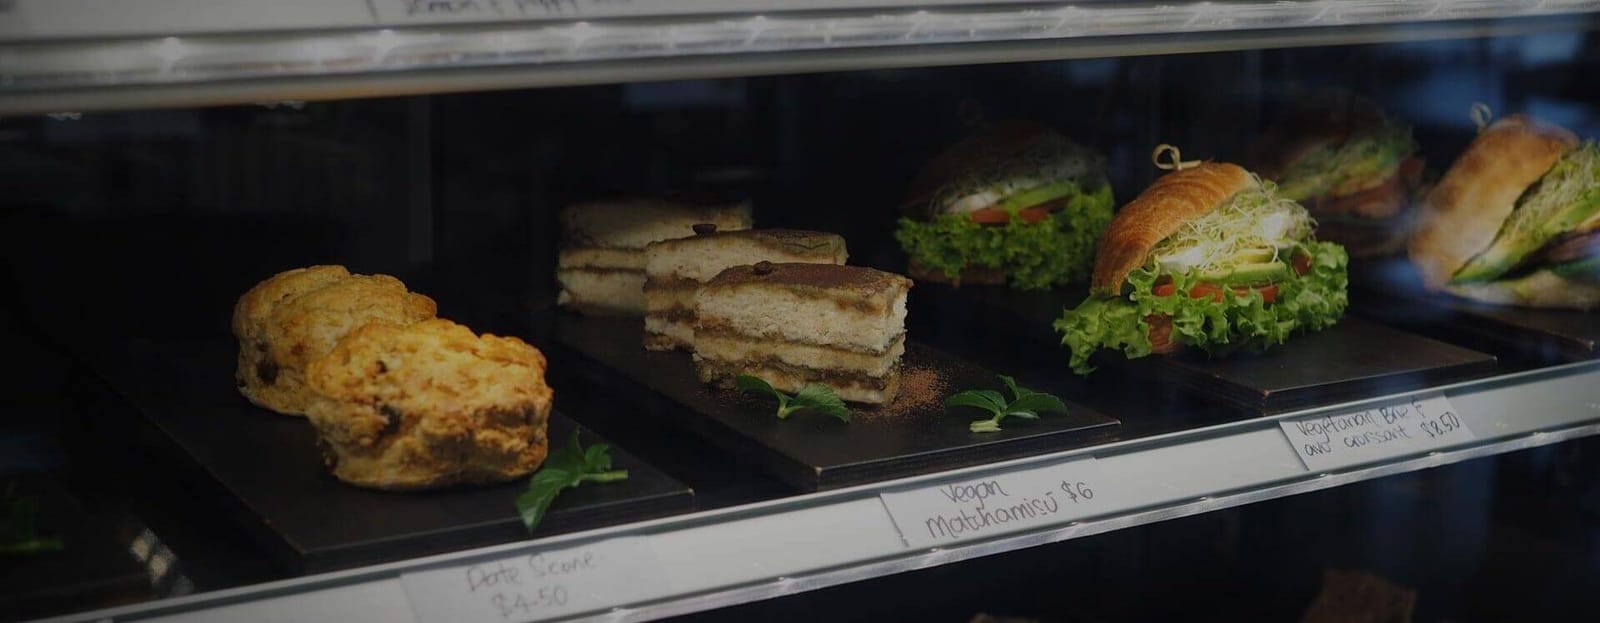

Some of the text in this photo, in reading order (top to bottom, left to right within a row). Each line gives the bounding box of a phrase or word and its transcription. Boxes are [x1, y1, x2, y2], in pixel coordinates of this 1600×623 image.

[1420, 411, 1461, 438] $8.50
[940, 480, 1009, 509] Vegan
[1061, 479, 1094, 503] $6
[528, 552, 597, 576] Scone
